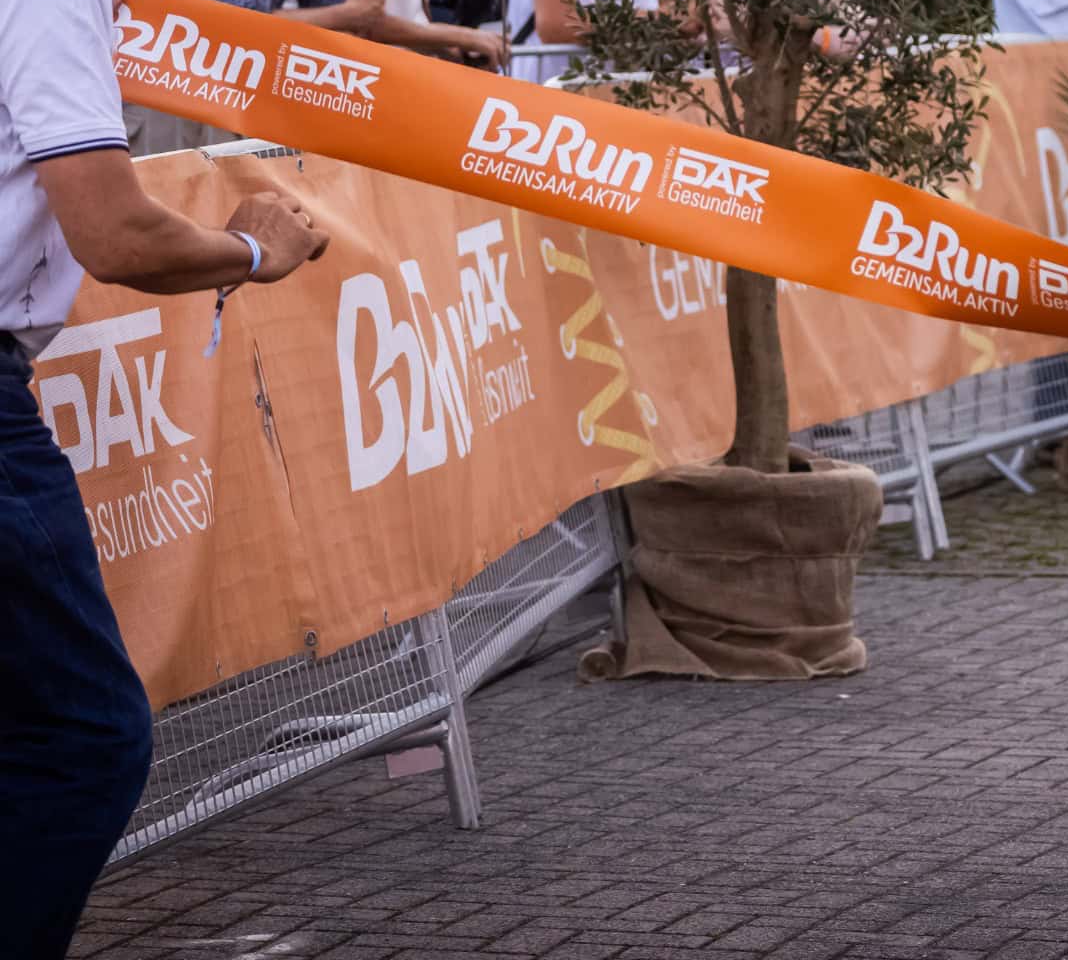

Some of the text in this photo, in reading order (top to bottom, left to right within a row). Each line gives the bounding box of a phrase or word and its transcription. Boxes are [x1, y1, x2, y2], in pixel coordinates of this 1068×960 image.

[115, 58, 256, 111] EINSAM. AKTIV
[282, 78, 375, 120] Gesundheit
[286, 44, 381, 100] DAK
[467, 97, 653, 192] B2Run
[461, 152, 641, 214] GEMEINSAM. AKTIV
[668, 181, 764, 224] Gesundheit
[673, 147, 770, 204] DAK
[857, 200, 1020, 299] B2Run
[851, 256, 961, 306] GEMEINSAM.
[963, 295, 1020, 317] AKTIV
[36, 307, 195, 475] DAK
